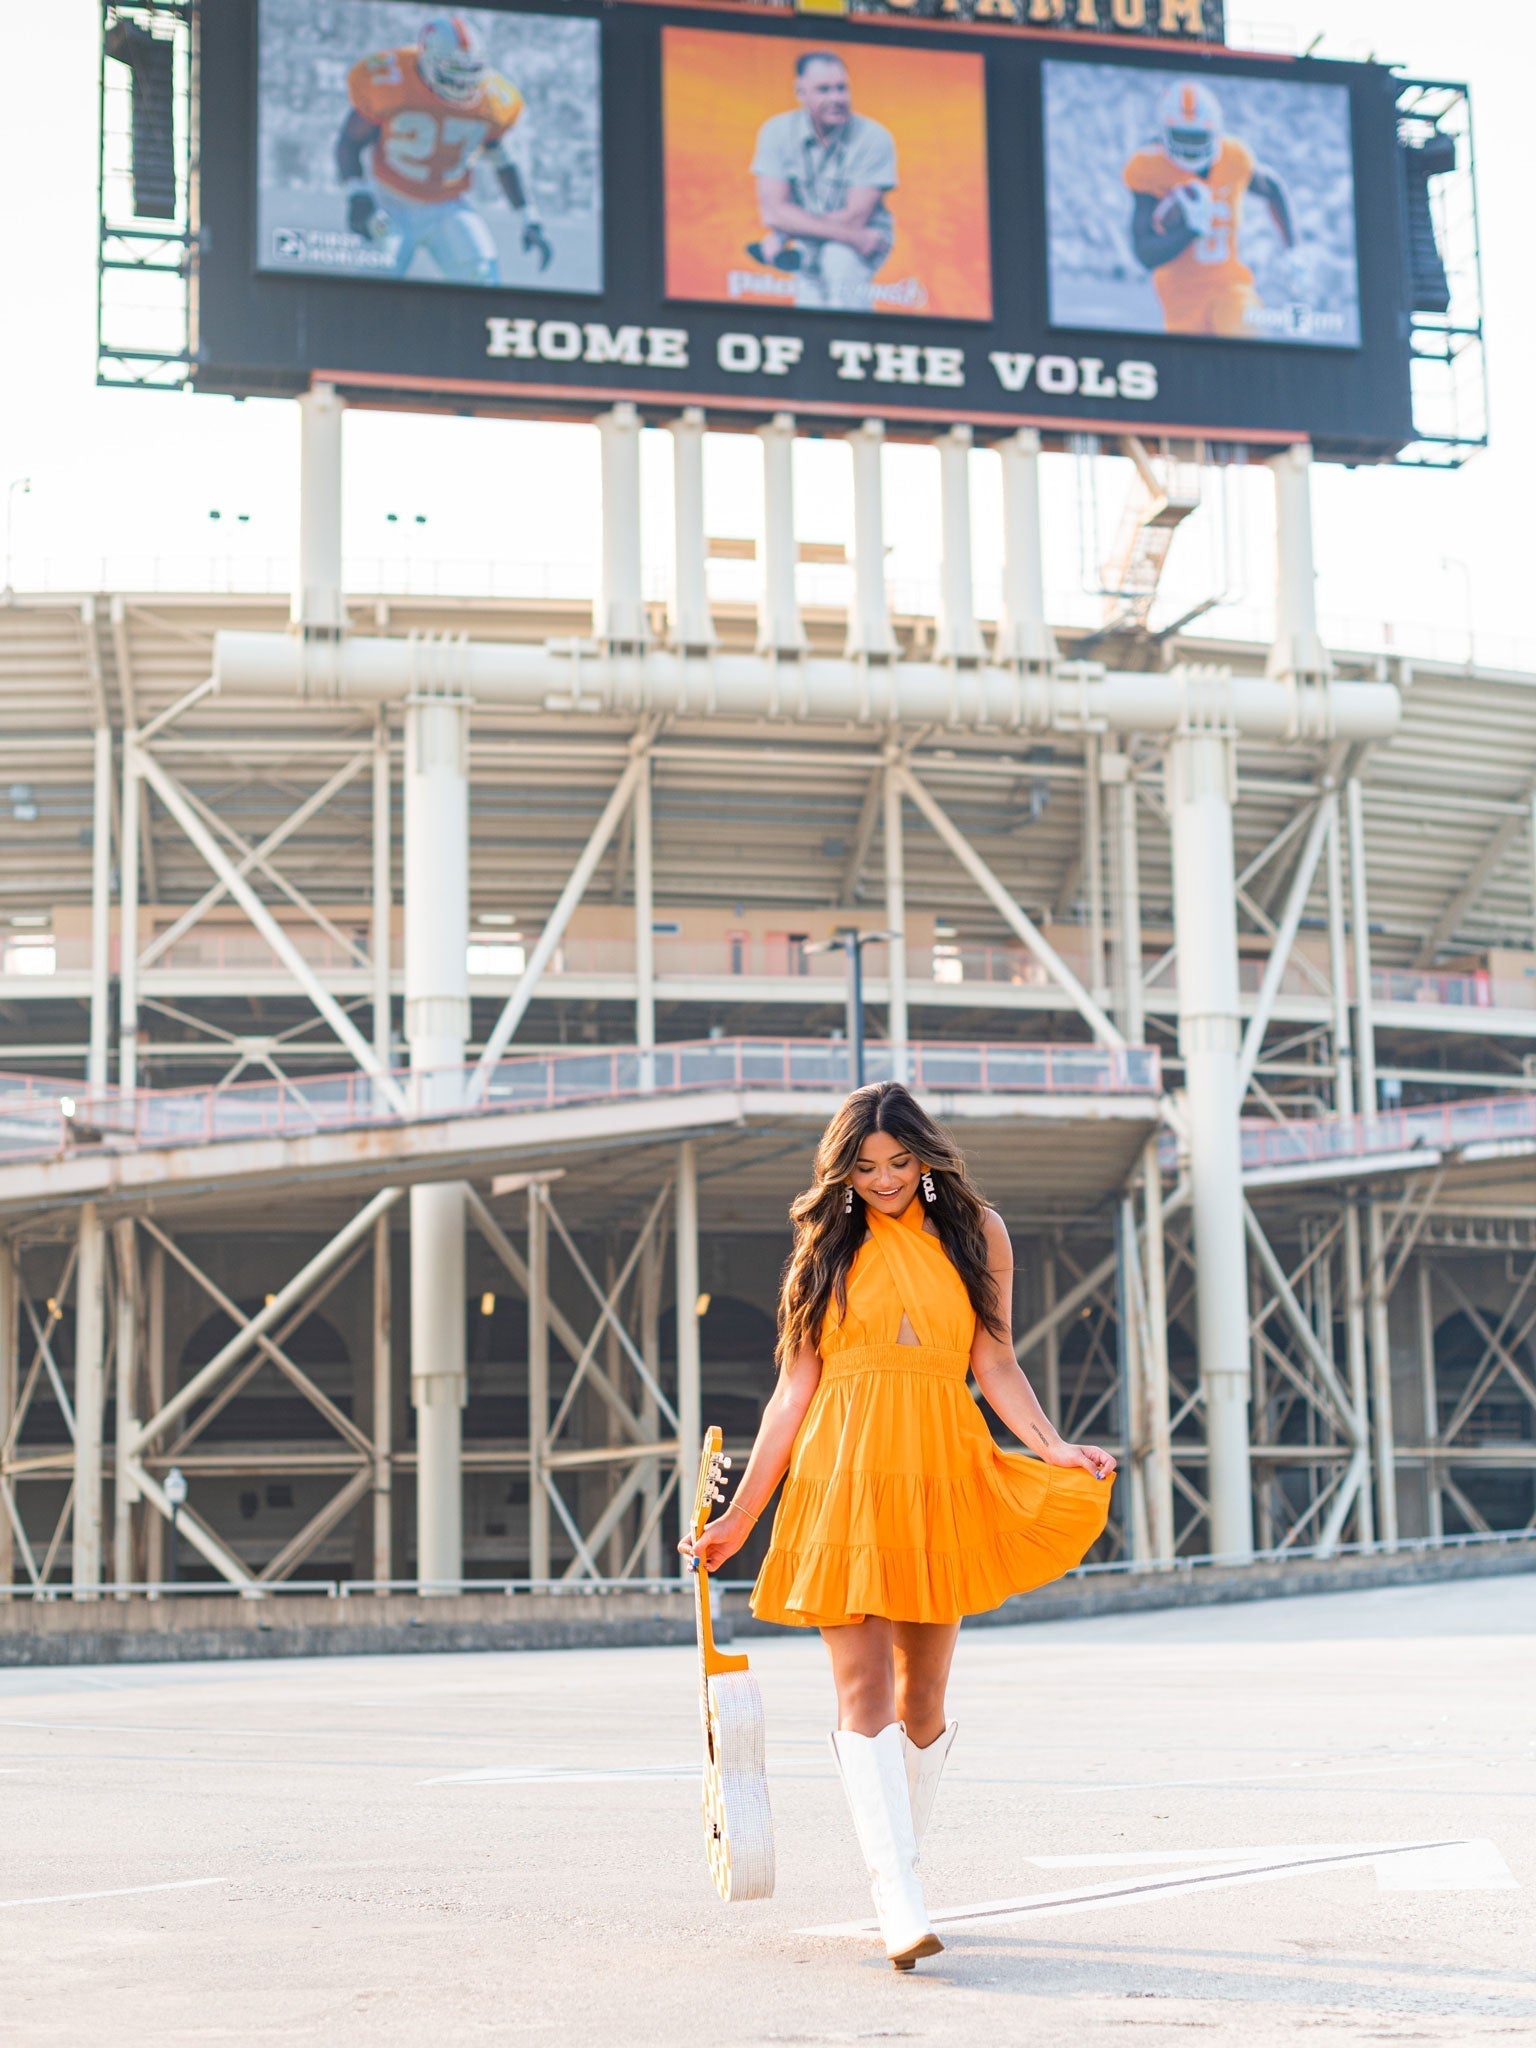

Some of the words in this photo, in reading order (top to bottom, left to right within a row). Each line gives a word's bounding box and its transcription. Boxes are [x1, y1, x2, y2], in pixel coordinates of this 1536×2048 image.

[887, 0, 1204, 33] DIUM
[385, 111, 488, 182] 27
[486, 317, 689, 369] HOME
[716, 332, 804, 375] OF
[829, 339, 965, 387] THE
[988, 351, 1158, 400] VOLS
[921, 1171, 937, 1203] VOLS
